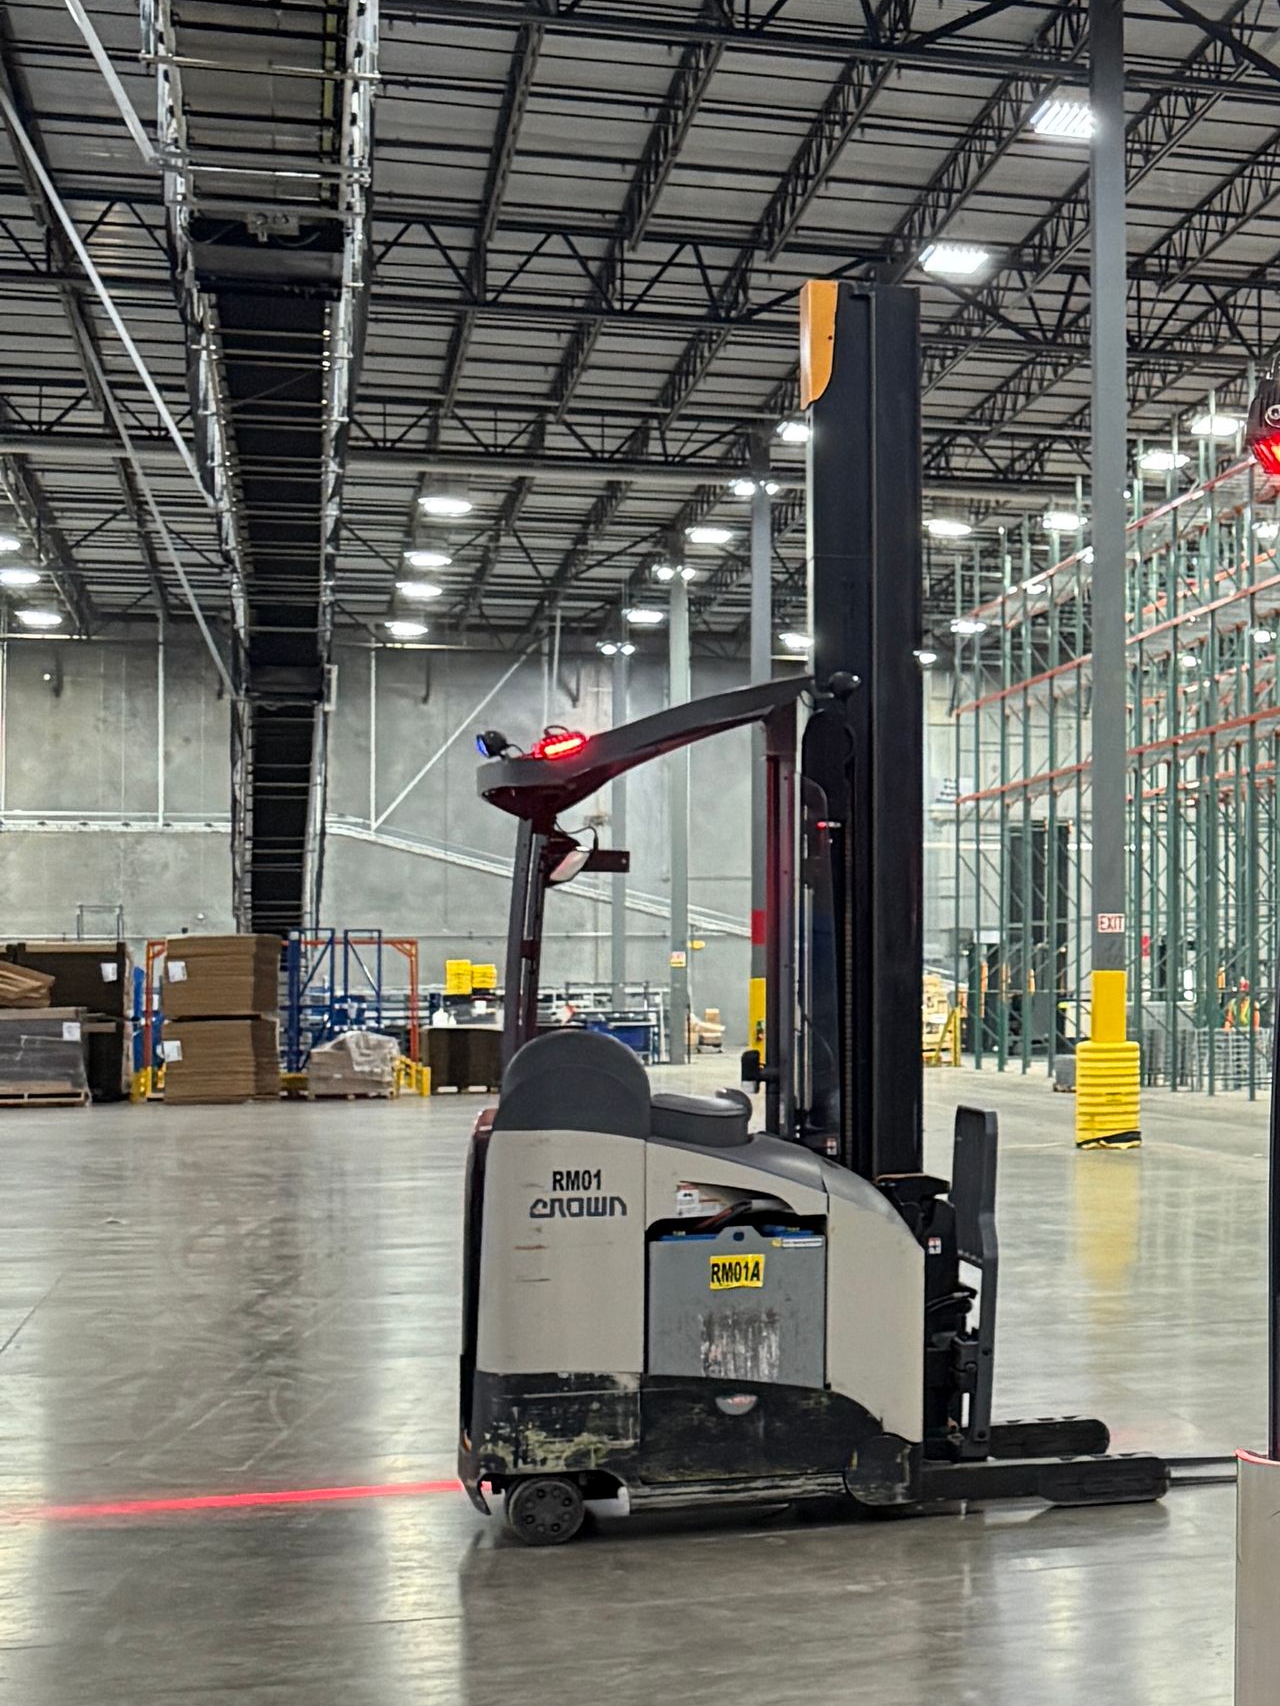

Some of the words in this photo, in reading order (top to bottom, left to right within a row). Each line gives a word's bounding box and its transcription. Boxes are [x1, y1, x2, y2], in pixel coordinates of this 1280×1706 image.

[1100, 915, 1124, 931] EXIT
[552, 1169, 602, 1192] RM01
[529, 1196, 627, 1218] CROWN
[711, 1260, 762, 1286] RM01A
